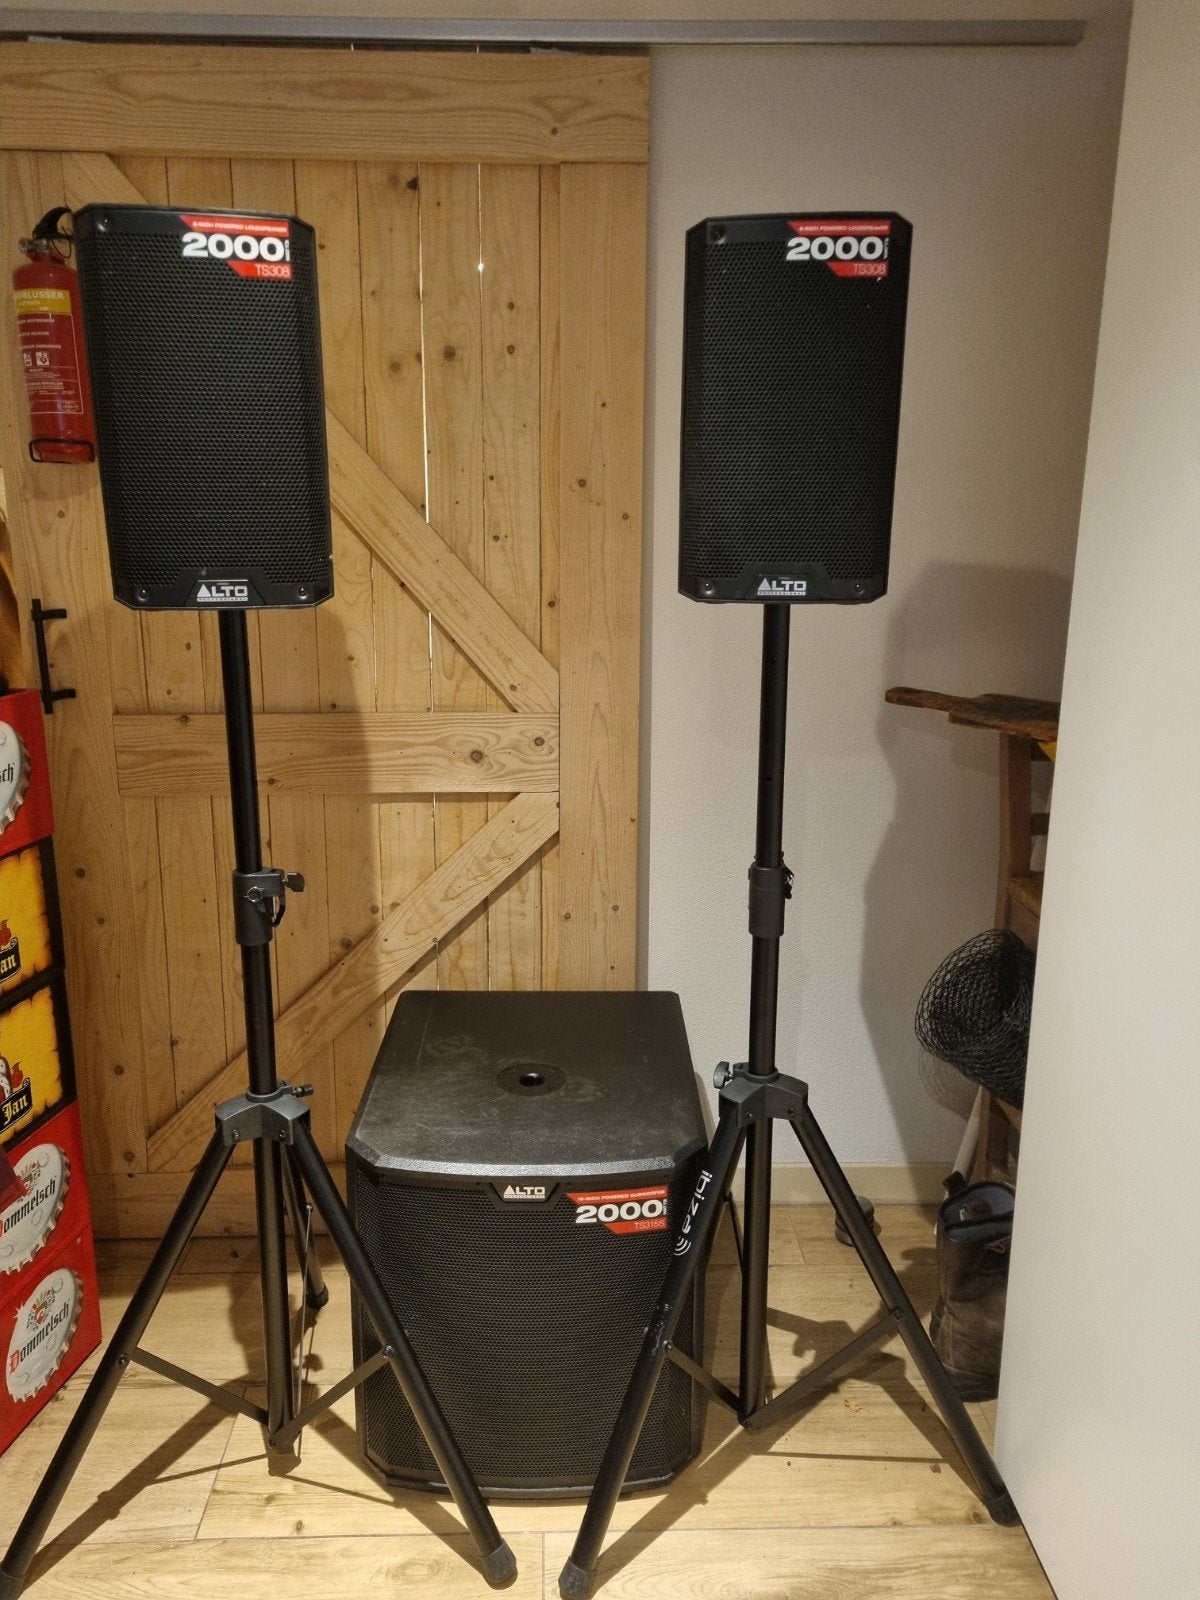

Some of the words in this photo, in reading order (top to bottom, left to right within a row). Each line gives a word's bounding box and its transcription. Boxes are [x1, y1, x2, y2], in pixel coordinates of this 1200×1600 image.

[182, 232, 285, 262] 2000
[786, 236, 884, 260] 2000
[255, 263, 290, 277] TS308
[197, 584, 248, 597] ALTO
[757, 577, 807, 591] ALTO
[2, 1095, 28, 1125] Jan
[503, 1185, 546, 1195] ALTO
[682, 1169, 713, 1234] ibiza
[575, 1199, 663, 1224] 2000
[634, 1221, 665, 1230] TS315S
[9, 1302, 69, 1375] Dommelsch
